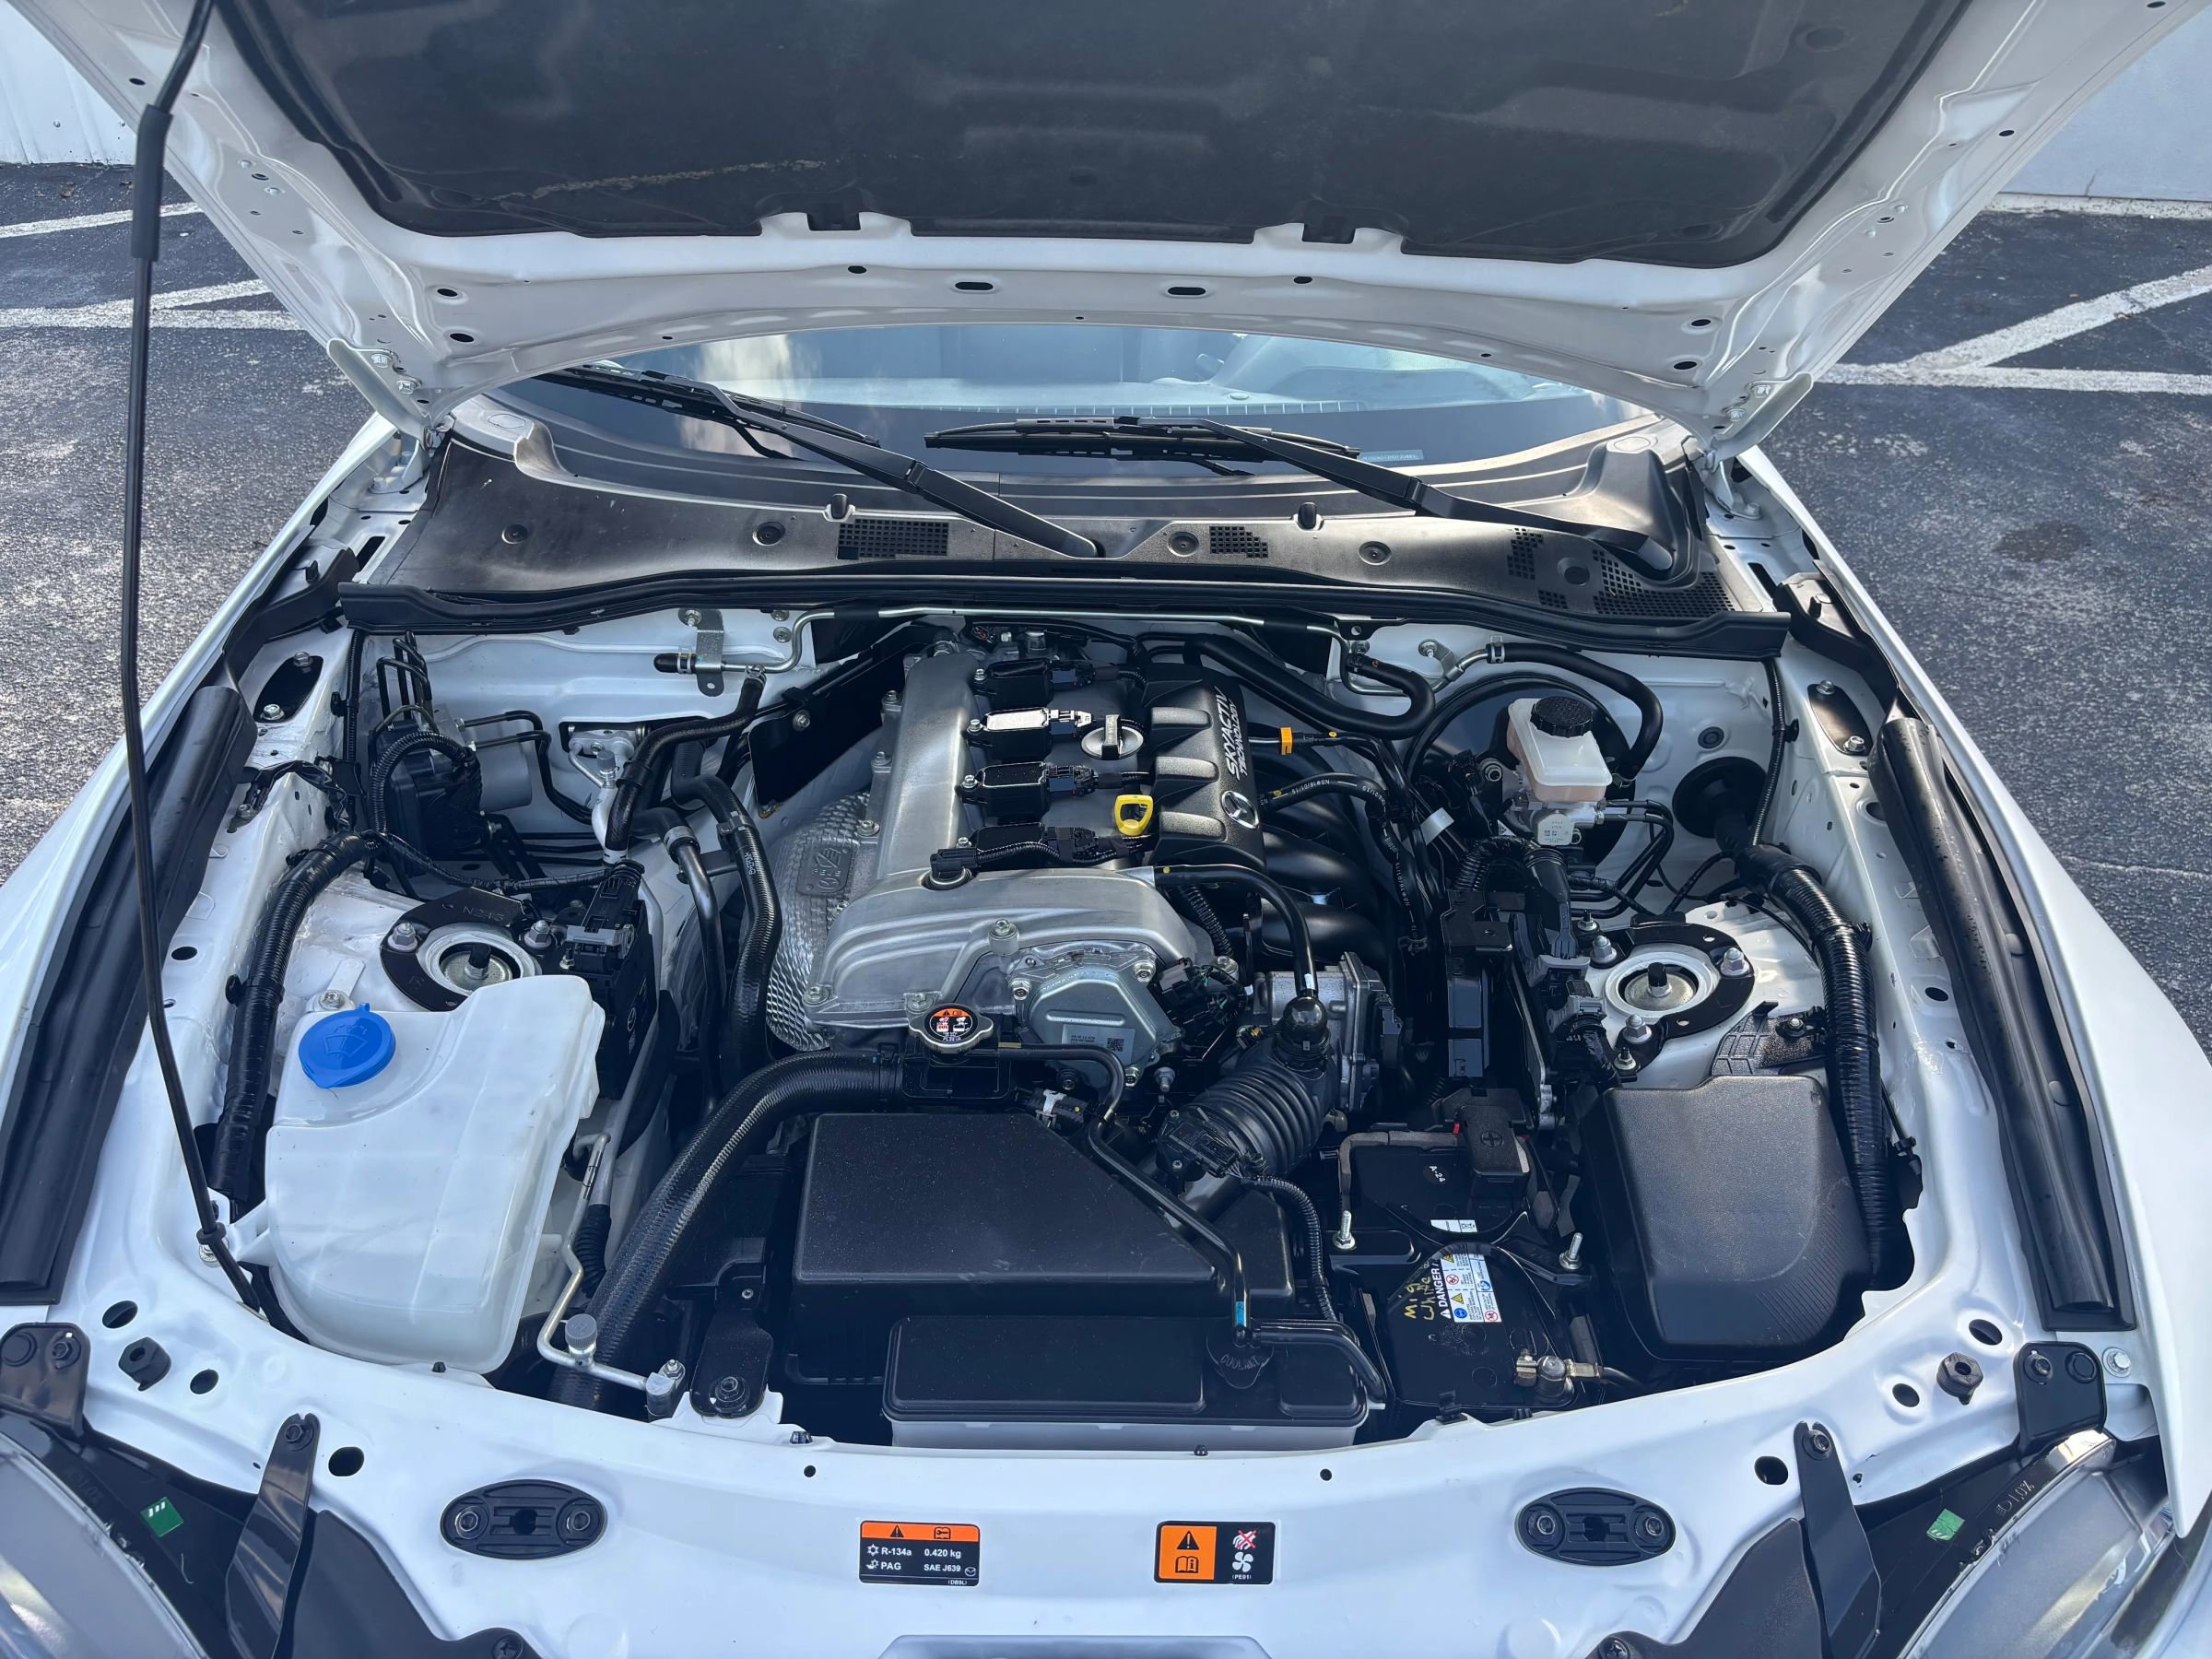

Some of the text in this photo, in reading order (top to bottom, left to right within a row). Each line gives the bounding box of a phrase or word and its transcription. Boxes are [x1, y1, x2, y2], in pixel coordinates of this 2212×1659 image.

[1214, 685, 1241, 781] SKYACTIV
[1229, 698, 1248, 776] TECHNOLOGY
[1430, 1267, 1448, 1308] DANGER
[880, 1547, 912, 1557] R-134a
[924, 1548, 962, 1559] 0.420 kg
[880, 1561, 901, 1571] PAG
[924, 1563, 961, 1572] SAE J639
